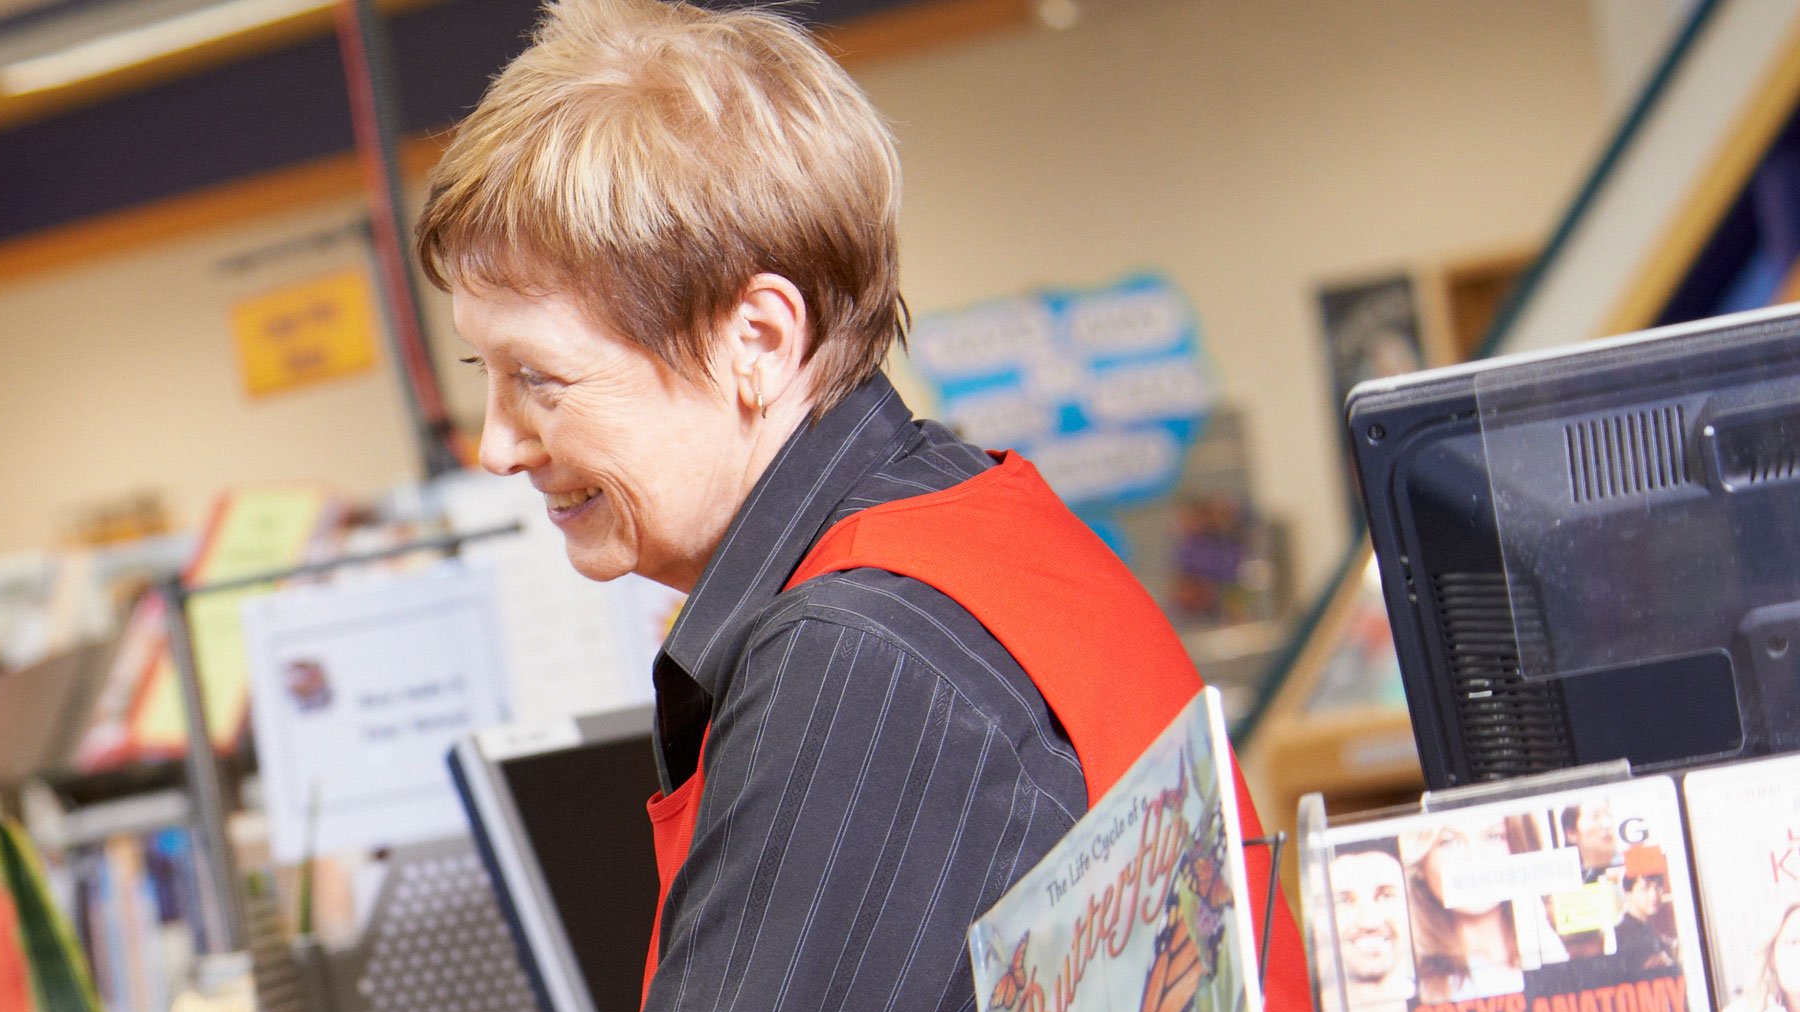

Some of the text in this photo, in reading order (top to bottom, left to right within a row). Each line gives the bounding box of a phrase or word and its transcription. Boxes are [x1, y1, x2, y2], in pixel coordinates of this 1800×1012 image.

[1046, 878, 1067, 907] The
[1068, 852, 1090, 887] Life
[1092, 817, 1125, 862] Cycle
[1127, 797, 1138, 826] of
[1618, 817, 1649, 844] G
